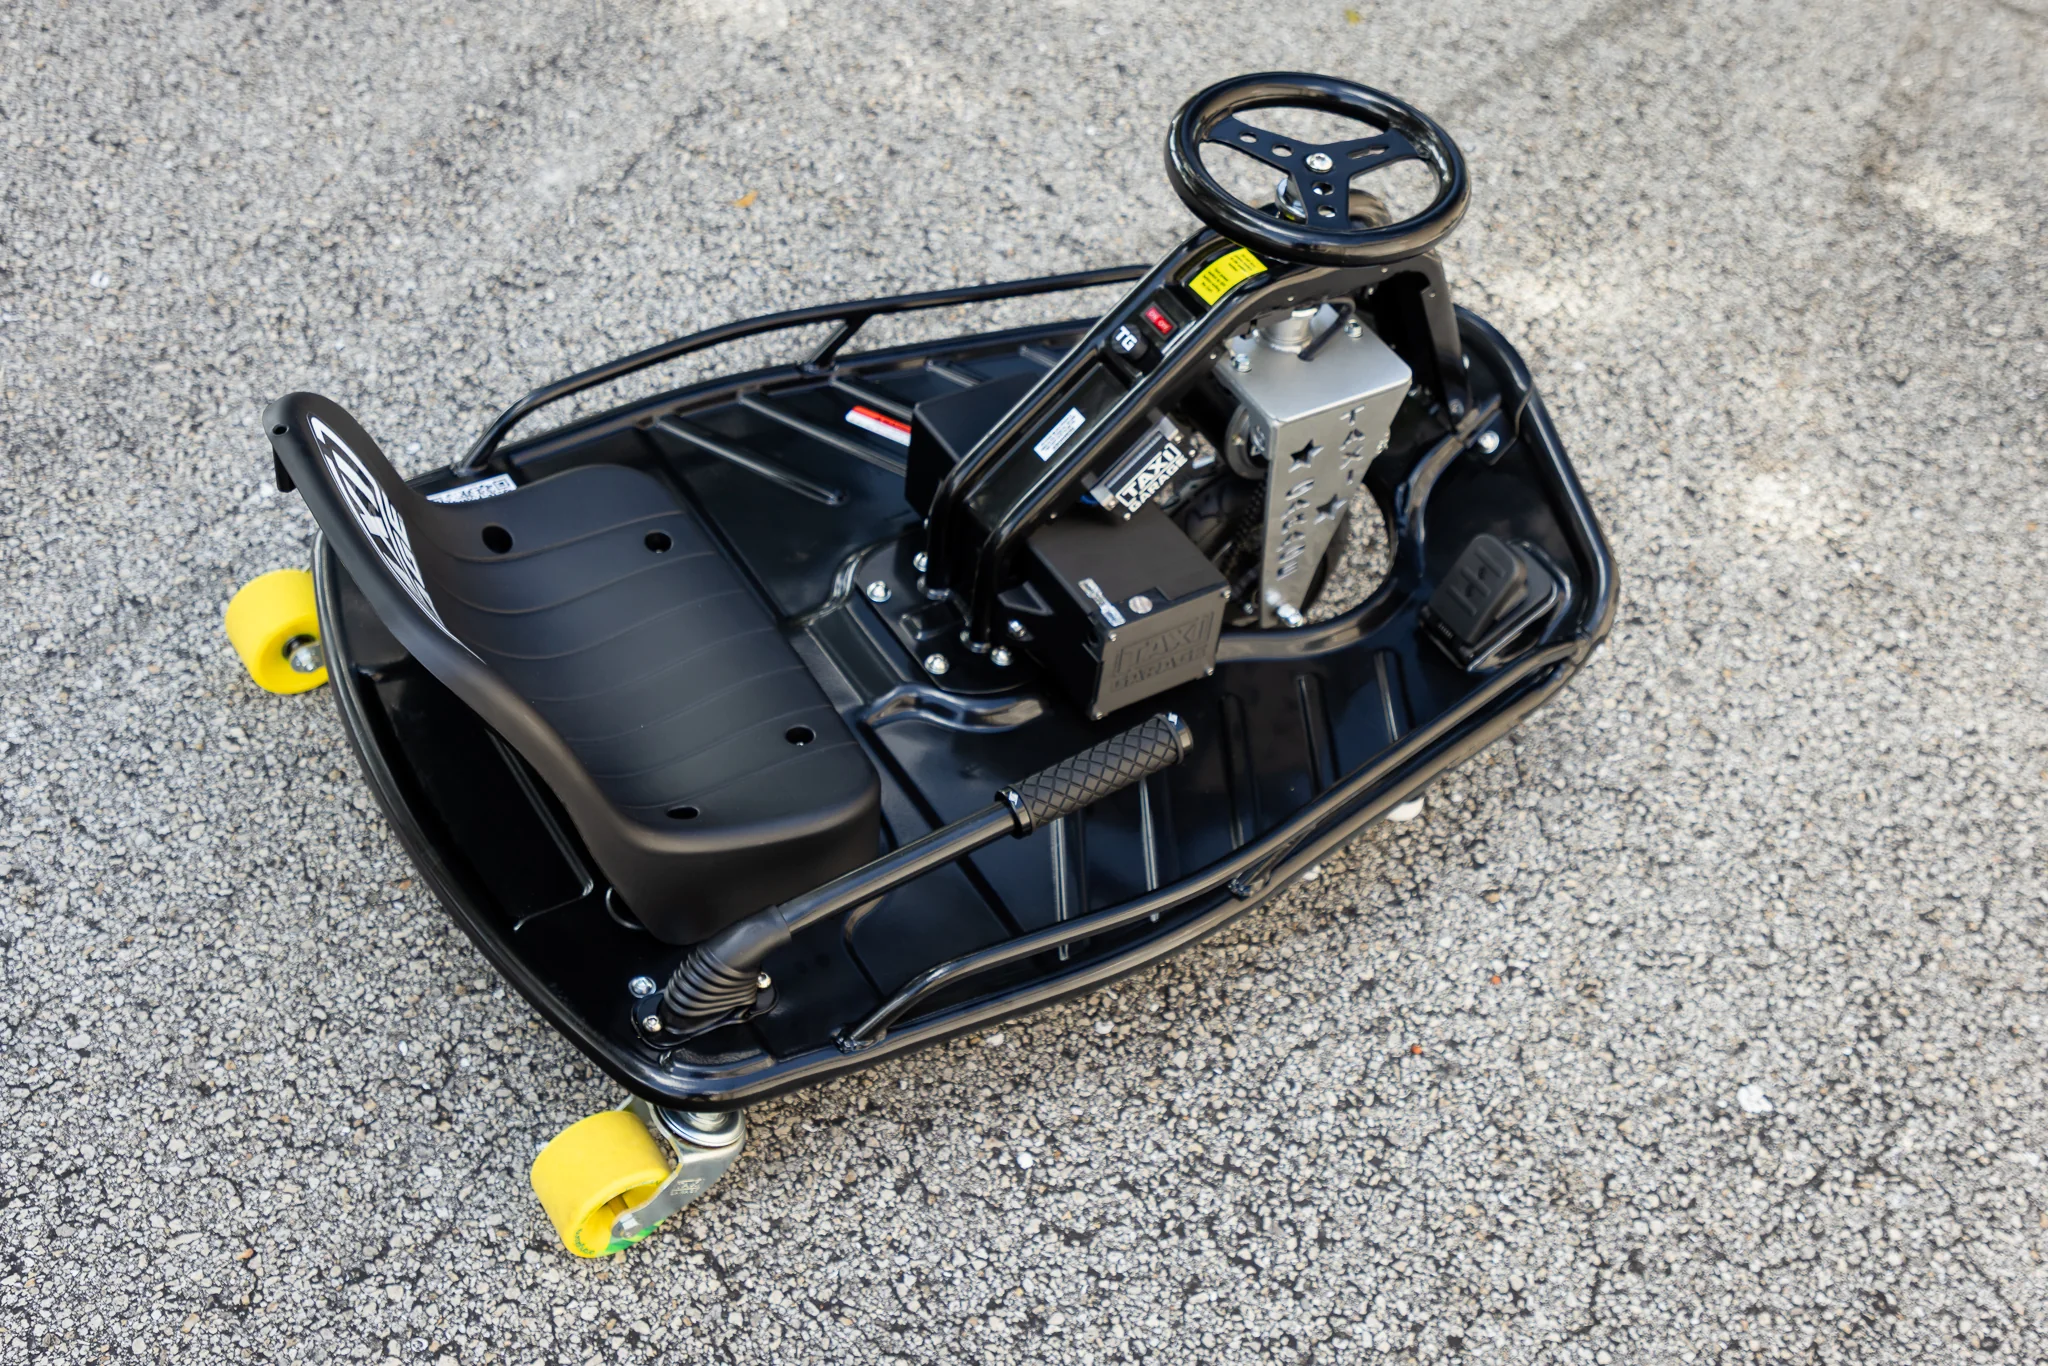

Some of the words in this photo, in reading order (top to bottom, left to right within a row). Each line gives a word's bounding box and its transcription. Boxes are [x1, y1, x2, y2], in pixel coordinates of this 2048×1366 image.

[1115, 325, 1138, 352] TG
[1117, 445, 1180, 502] TAXI
[1340, 406, 1365, 486] TAXI
[1128, 455, 1188, 513] GARAGE
